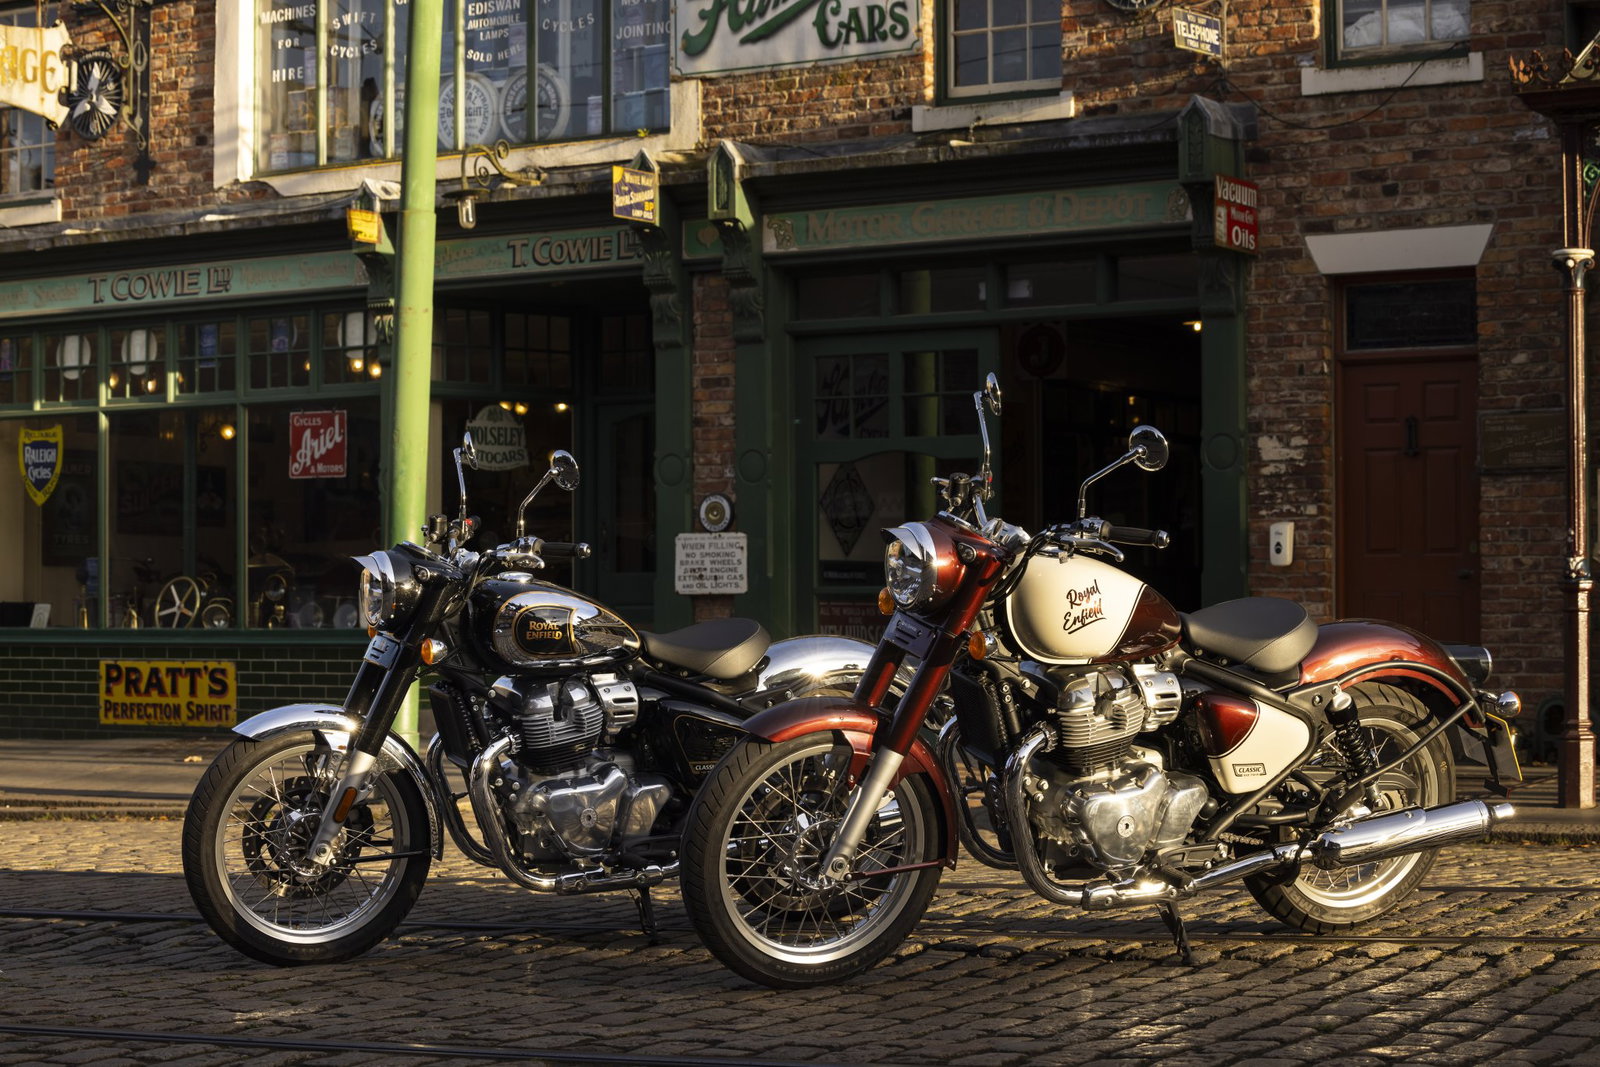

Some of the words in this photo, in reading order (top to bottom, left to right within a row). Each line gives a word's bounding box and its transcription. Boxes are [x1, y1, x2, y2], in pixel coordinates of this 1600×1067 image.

[260, 4, 316, 24] MACHINES
[468, 0, 520, 16] EDISWAN
[332, 11, 376, 30] SWIFT
[467, 13, 521, 30] AUTOMOBILE
[542, 13, 594, 33] CYCLES
[812, 0, 910, 48] CARS
[480, 28, 509, 41] LAMPS
[1175, 20, 1220, 45] TELEPHONE
[278, 37, 300, 50] FOR
[330, 39, 378, 59] CYCLES
[466, 48, 493, 63] SOLD
[272, 66, 304, 83] HIRE
[1216, 175, 1257, 208] Vacuum
[1232, 226, 1256, 250] Oils
[508, 237, 530, 269] T.
[533, 233, 614, 266] COWIE
[88, 273, 107, 303] T.
[111, 267, 201, 302] COWIE
[294, 415, 322, 427] CYCLES
[24, 445, 57, 465] RALEIGH
[316, 462, 344, 473] MOTORS
[700, 551, 736, 559] SMOKING
[708, 541, 741, 550] FILLING
[679, 559, 705, 567] BRAKE
[1066, 579, 1101, 610] Royal
[1063, 598, 1103, 632] Enfield
[526, 630, 563, 640] ENFIELD
[530, 620, 559, 631] ROYAL
[105, 664, 228, 698] PRATT'S
[104, 700, 181, 720] PERFECTION
[186, 701, 231, 721] SPIRIT
